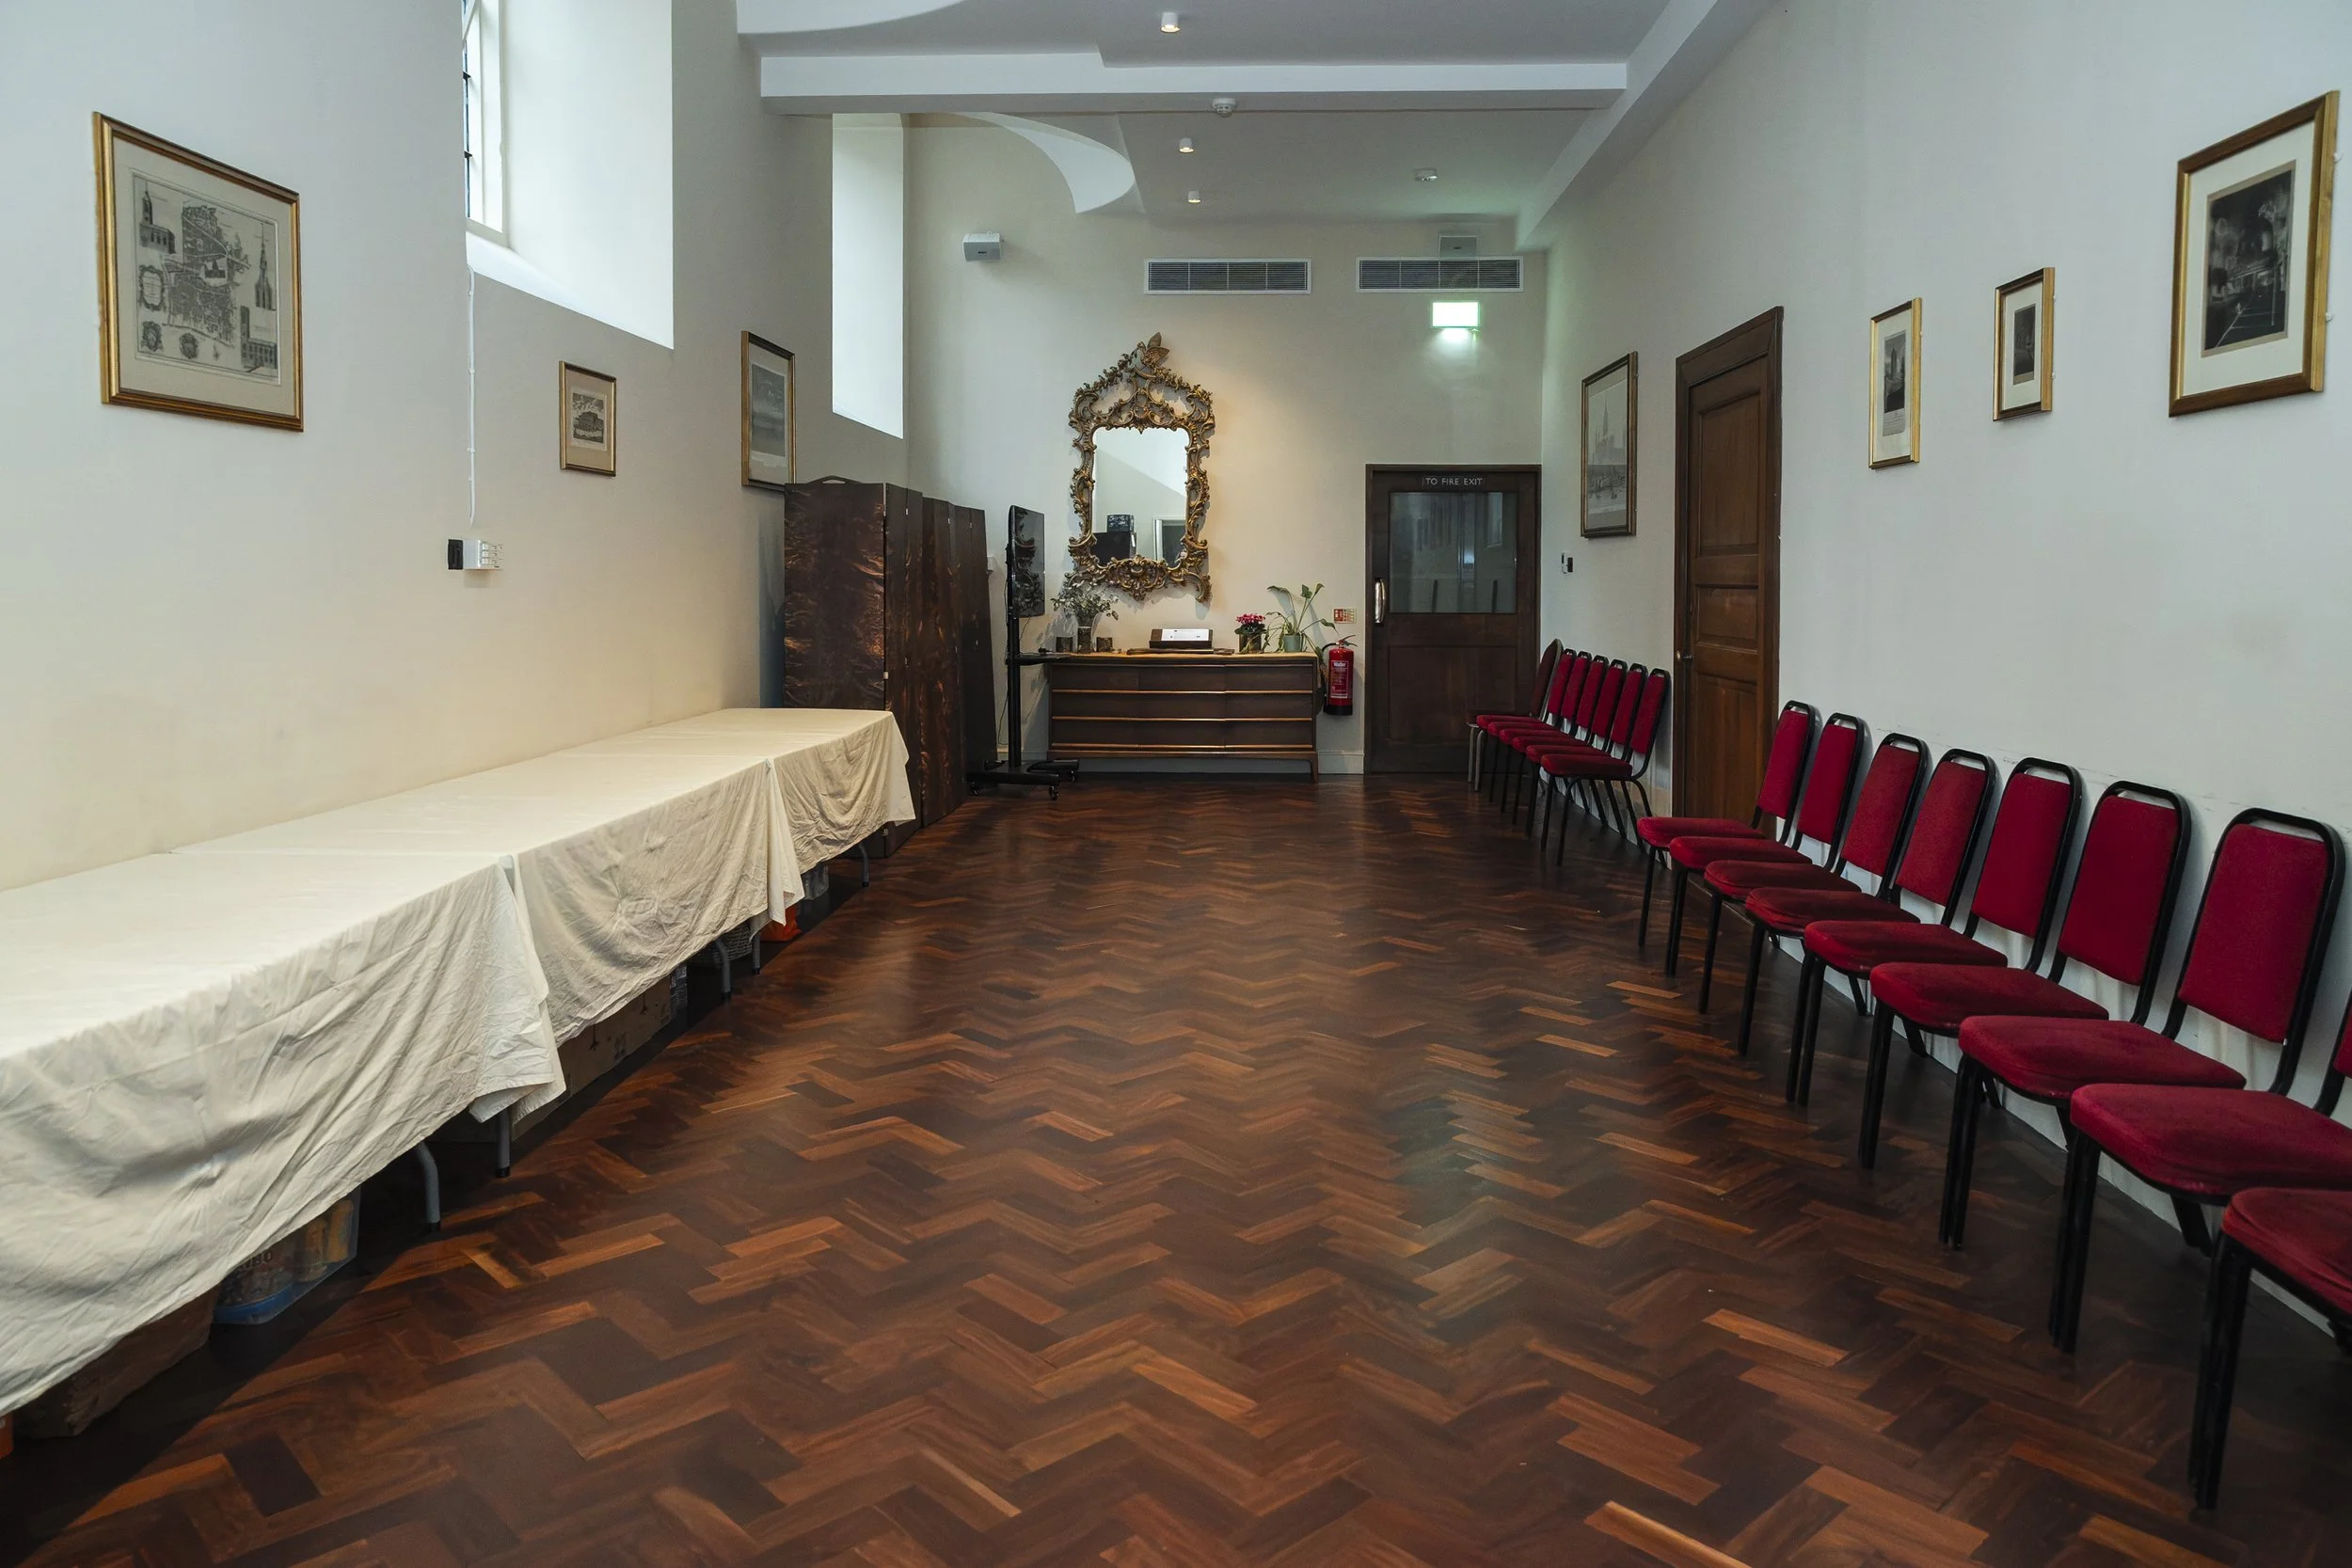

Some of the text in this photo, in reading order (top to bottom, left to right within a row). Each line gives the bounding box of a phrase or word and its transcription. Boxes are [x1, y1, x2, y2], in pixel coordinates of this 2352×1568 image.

[1425, 477, 1483, 485] TO FIRE EXIT
